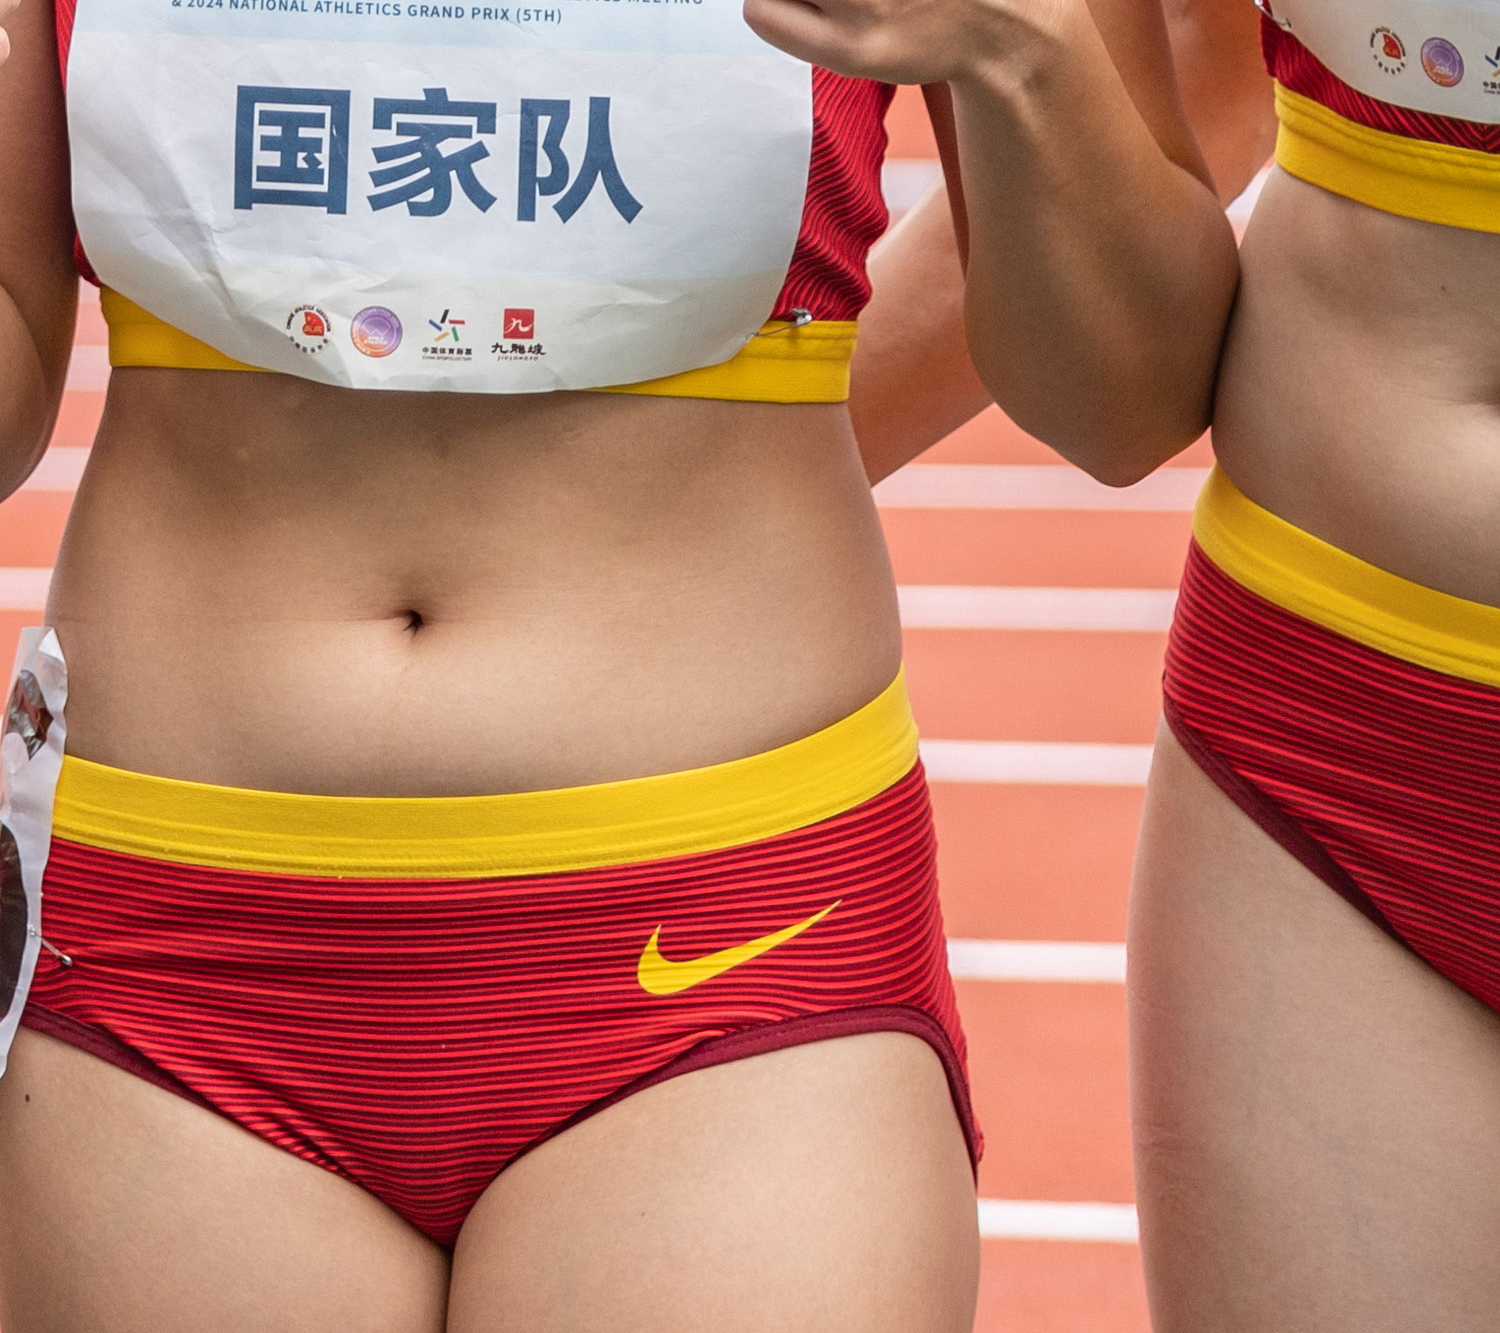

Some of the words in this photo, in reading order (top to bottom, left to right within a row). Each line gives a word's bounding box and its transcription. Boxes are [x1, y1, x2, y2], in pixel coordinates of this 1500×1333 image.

[314, 0, 401, 16] ATHLETICS
[407, 4, 465, 19] GRAND
[471, 7, 510, 21] PRIX
[516, 7, 562, 24] (5TH)
[232, 85, 643, 225] 国家队
